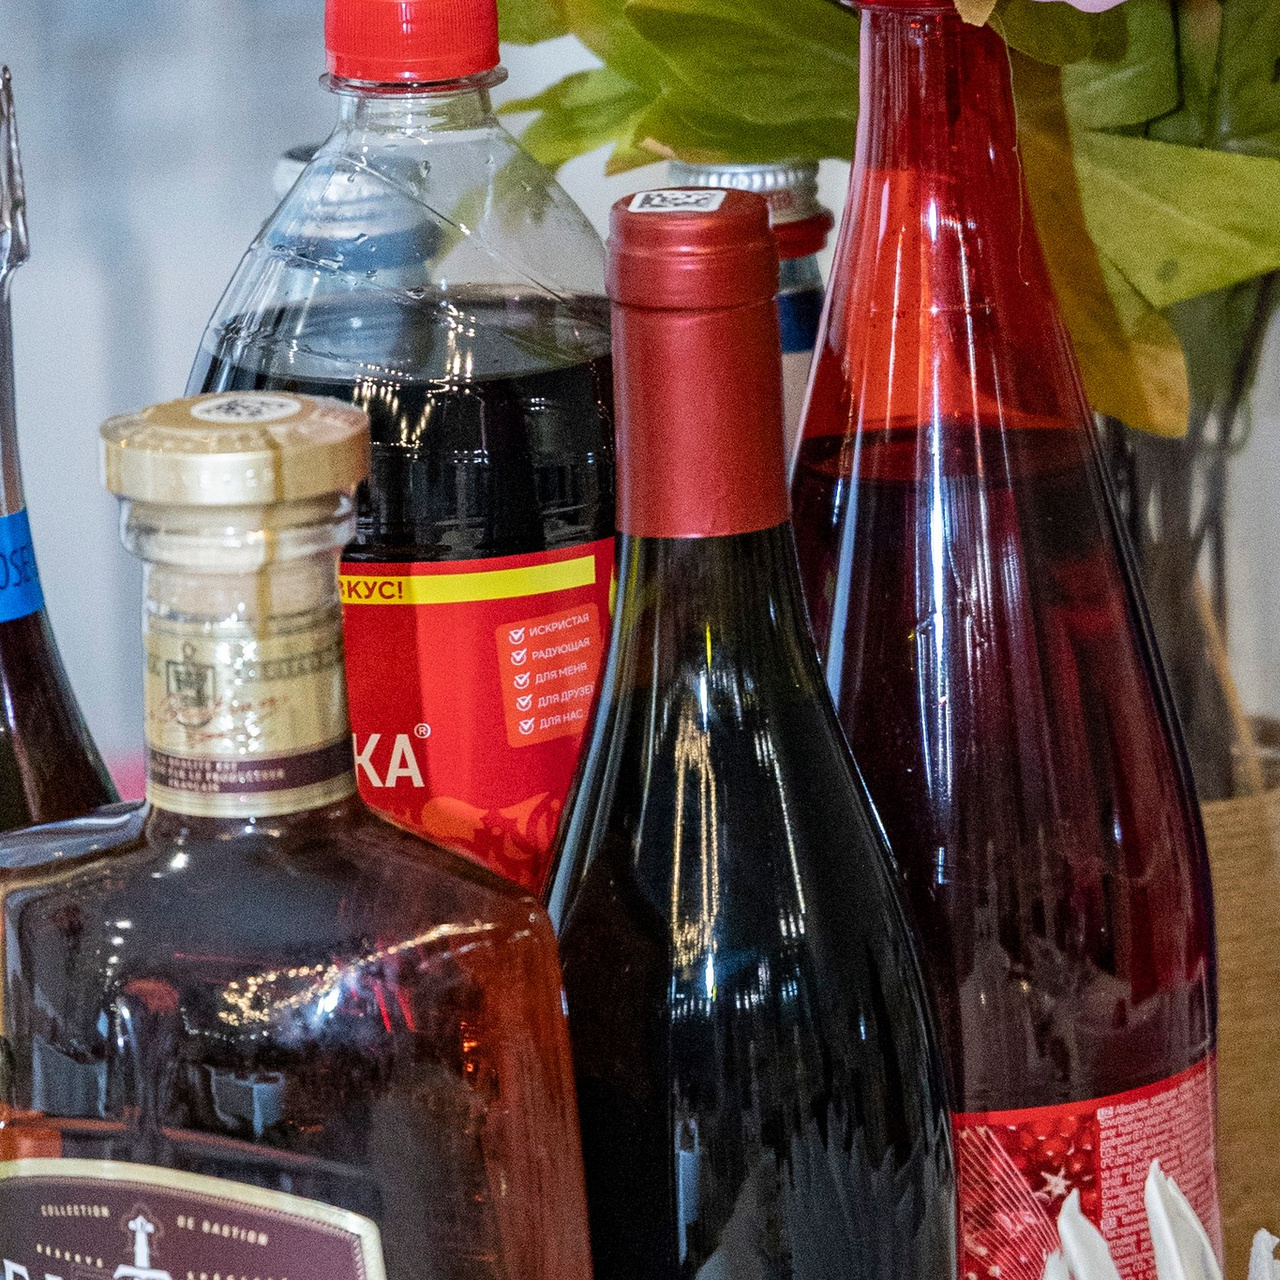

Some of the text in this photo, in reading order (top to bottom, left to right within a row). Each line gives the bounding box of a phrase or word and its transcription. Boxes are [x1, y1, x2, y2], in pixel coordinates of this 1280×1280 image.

[529, 613, 590, 637] ИСКРИСТАЯ
[532, 637, 590, 661] РАДУЮЩАЯ
[535, 662, 588, 685] ДЛЯ МЕНЯ
[538, 693, 559, 708] ДЛЯ
[539, 708, 584, 730] ДЛЯ НАС
